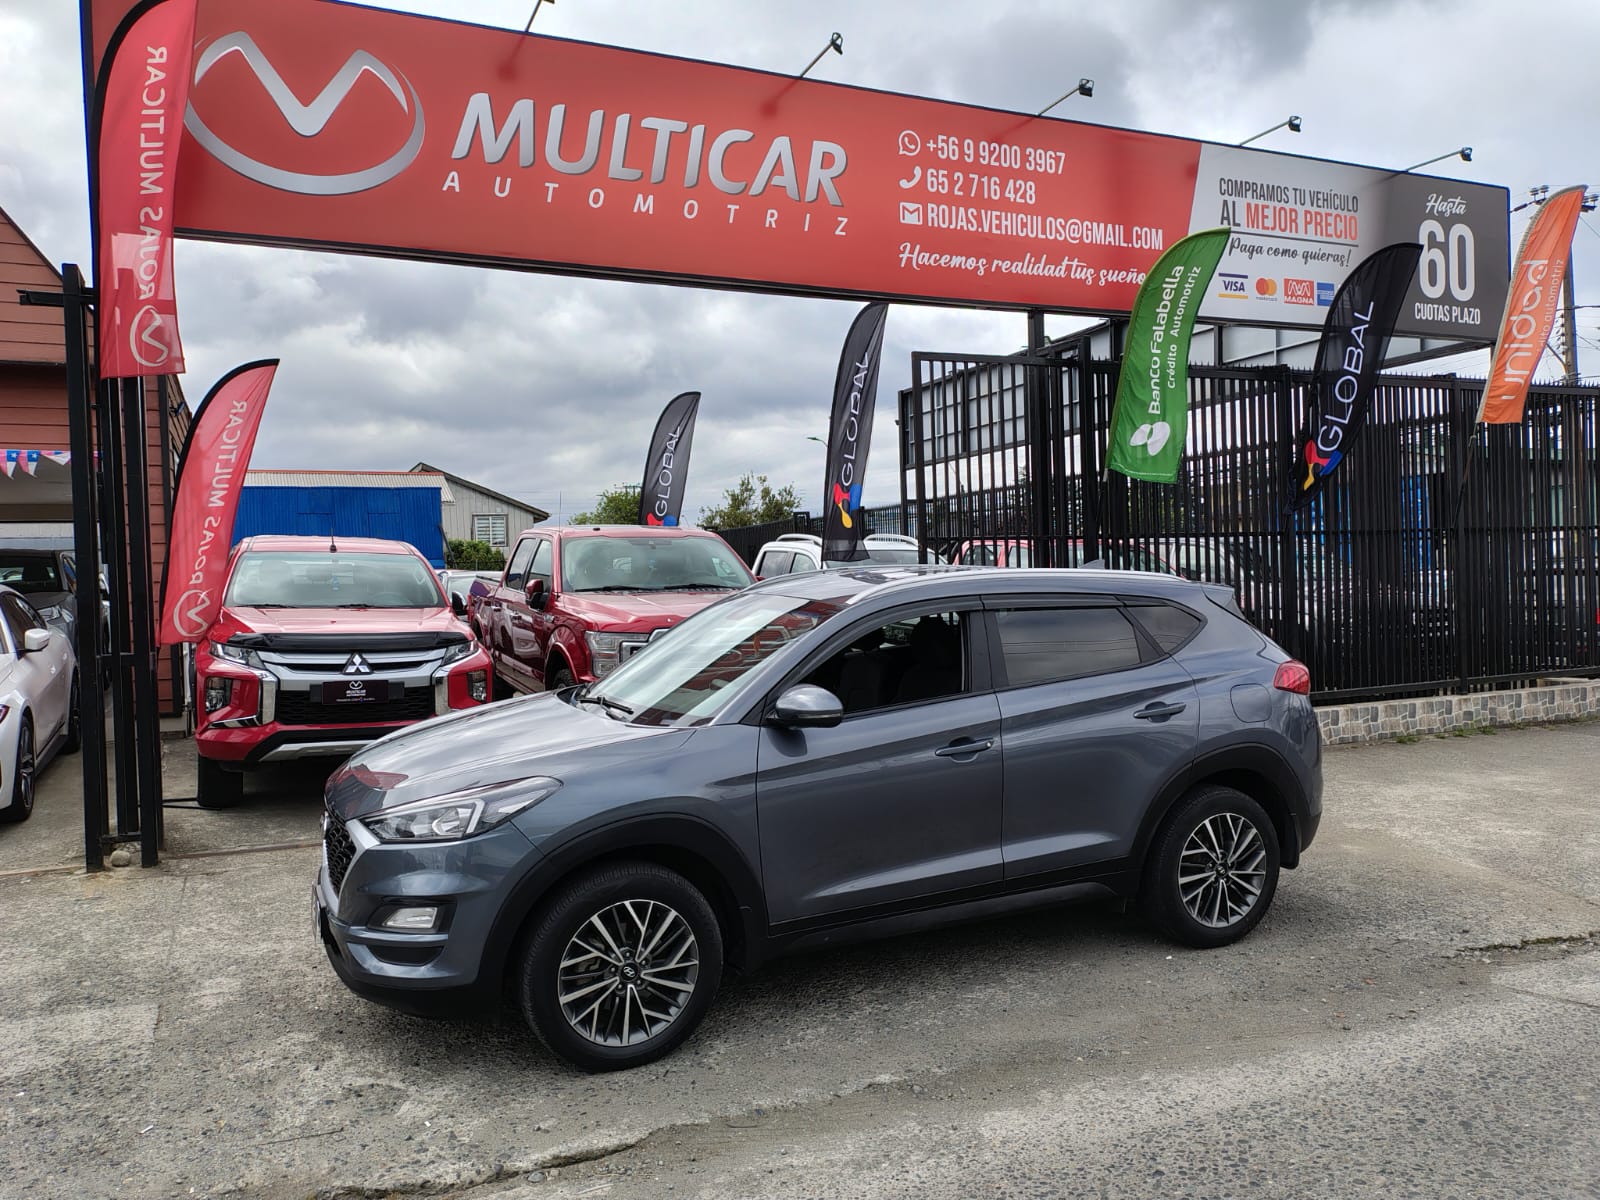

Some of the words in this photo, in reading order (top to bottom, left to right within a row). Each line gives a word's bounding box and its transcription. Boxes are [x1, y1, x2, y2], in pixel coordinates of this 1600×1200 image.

[451, 92, 849, 207] MULTICAR
[926, 134, 959, 160] +56
[964, 139, 974, 162] 9
[979, 140, 1021, 169] 9200
[1026, 147, 1066, 175] 3967
[442, 170, 849, 237] AUTOMOTRIZ
[926, 168, 949, 194] 65
[953, 172, 964, 196] 2
[969, 173, 1001, 200] 716
[1005, 178, 1036, 205] 428
[1219, 178, 1289, 205] COMPRAMOS
[1293, 187, 1307, 207] TU
[1309, 188, 1359, 213] VEHÍCULO
[1425, 193, 1467, 217] Hasta
[926, 202, 1163, 251] ROJAS.VEHICULOS@GMAIL.COM
[1220, 199, 1241, 227] AL
[1245, 202, 1299, 233] MEJOR
[1303, 210, 1358, 241] PRECIO
[899, 242, 989, 276] Hacemos
[991, 252, 1069, 278] realidad
[1067, 257, 1097, 286] tus
[1098, 267, 1147, 287] sueño
[1229, 236, 1264, 260] Paga
[1266, 245, 1298, 259] como
[1302, 249, 1352, 268] quieras!
[1418, 219, 1475, 302] 60
[1150, 265, 1185, 354] Falabella
[1172, 266, 1202, 337] Automotriz
[1222, 279, 1245, 293] VISA
[1414, 302, 1450, 323] CUOTAS
[1451, 306, 1481, 326] PLAZO
[1148, 356, 1162, 415] Banco
[1167, 344, 1178, 389] Crédito
[1316, 301, 1374, 452] GLOBAL
[841, 352, 869, 487] GLOBAL
[655, 425, 681, 517] GLOBAL
